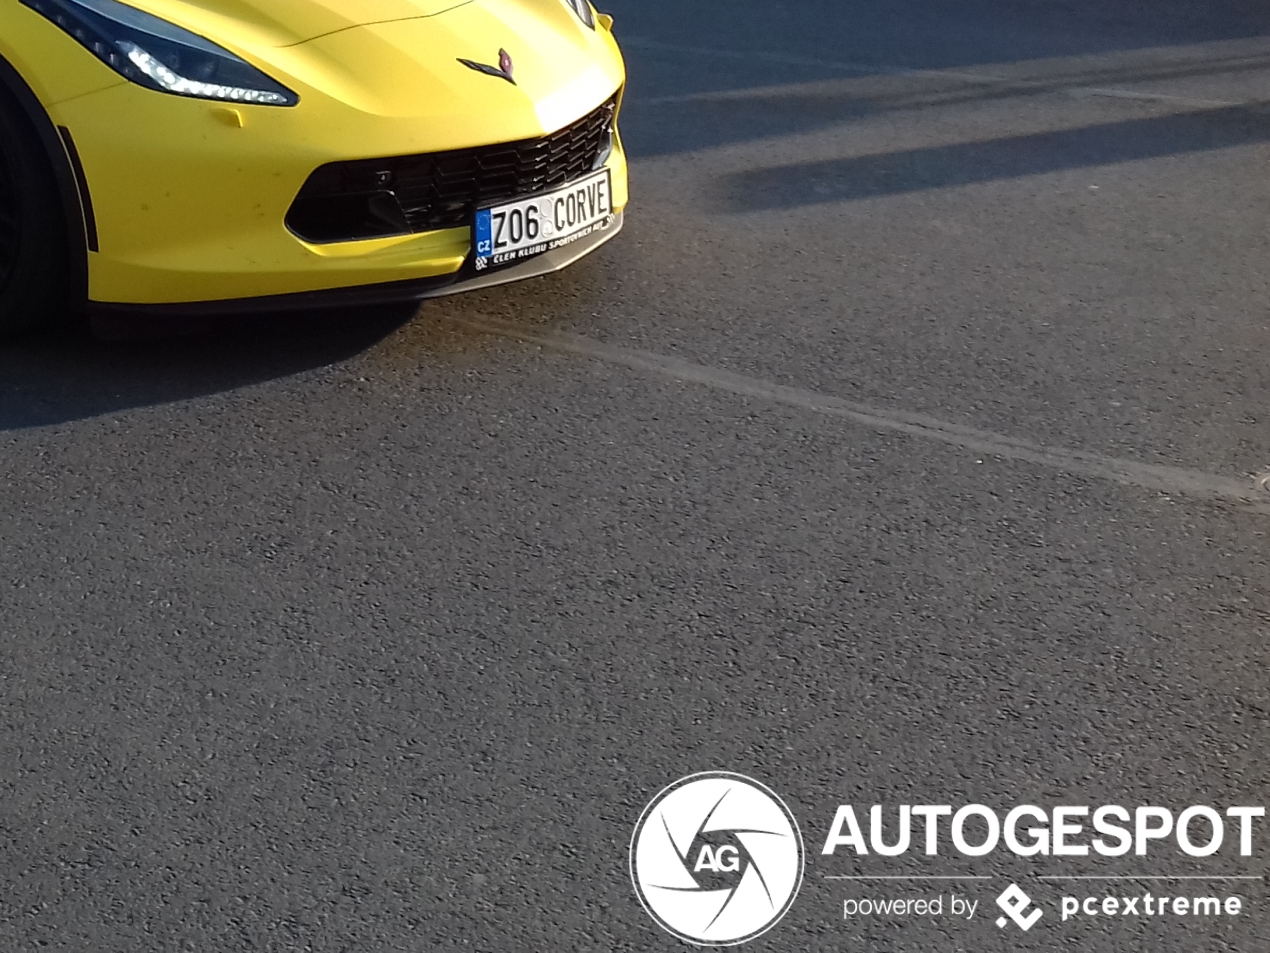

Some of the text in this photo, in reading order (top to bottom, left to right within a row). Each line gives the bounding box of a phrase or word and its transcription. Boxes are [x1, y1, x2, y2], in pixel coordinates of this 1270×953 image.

[477, 179, 608, 253] CZ Z06 CORVE
[518, 244, 547, 258] KLUBU
